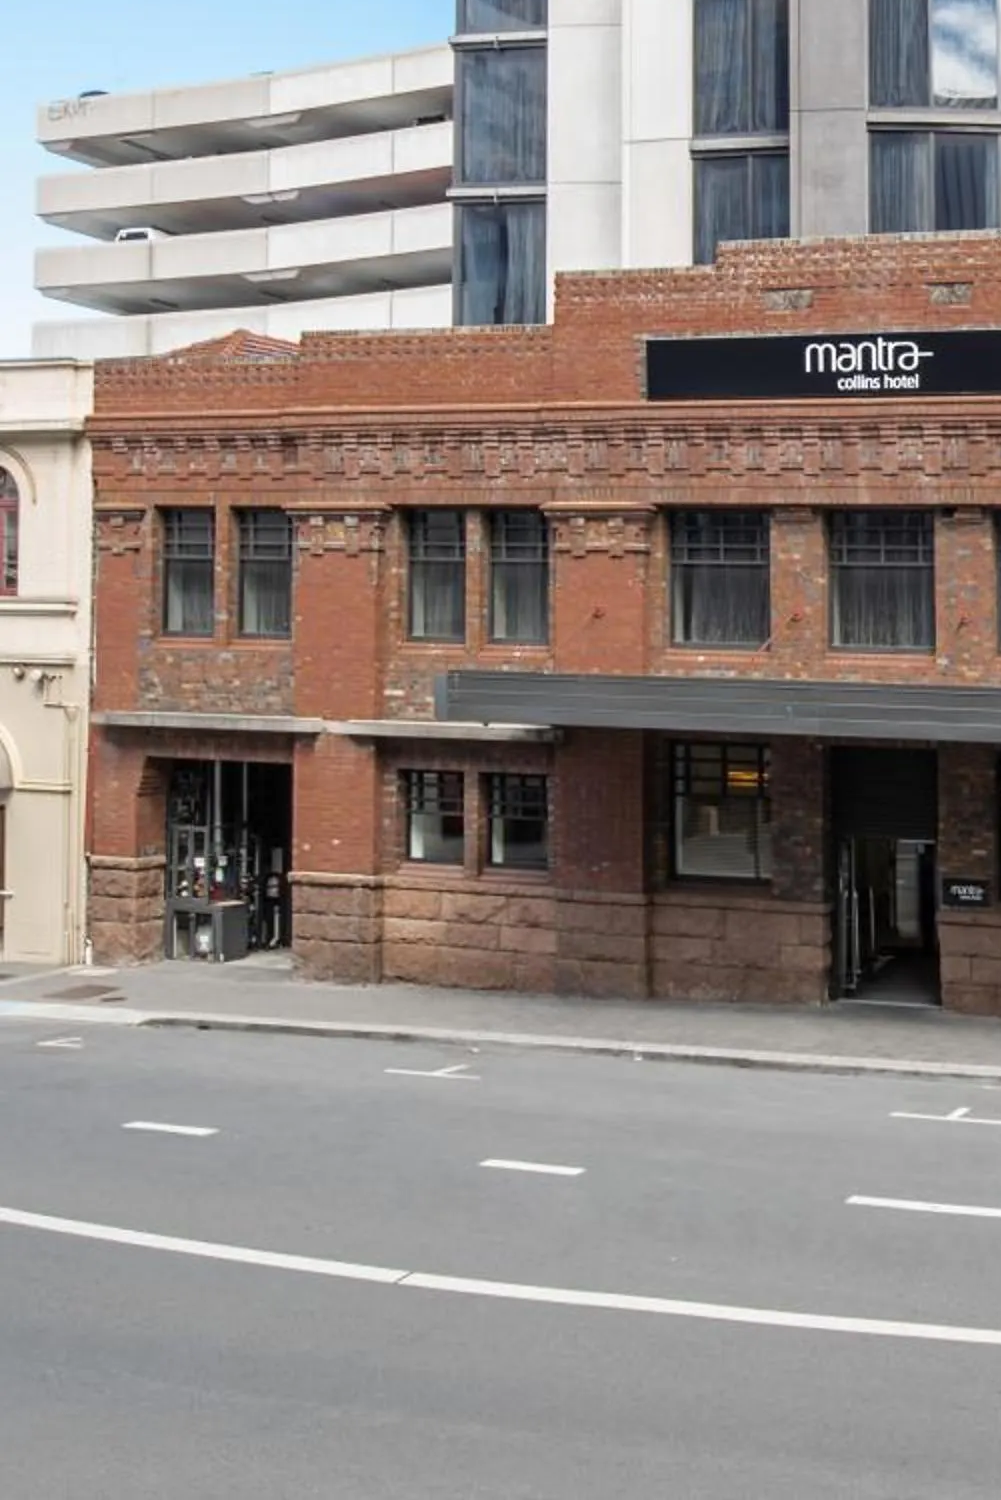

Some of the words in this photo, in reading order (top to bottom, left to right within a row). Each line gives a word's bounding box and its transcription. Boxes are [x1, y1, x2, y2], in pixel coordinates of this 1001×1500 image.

[805, 337, 934, 373] mantra
[837, 374, 880, 390] collins
[883, 373, 919, 389] hotel
